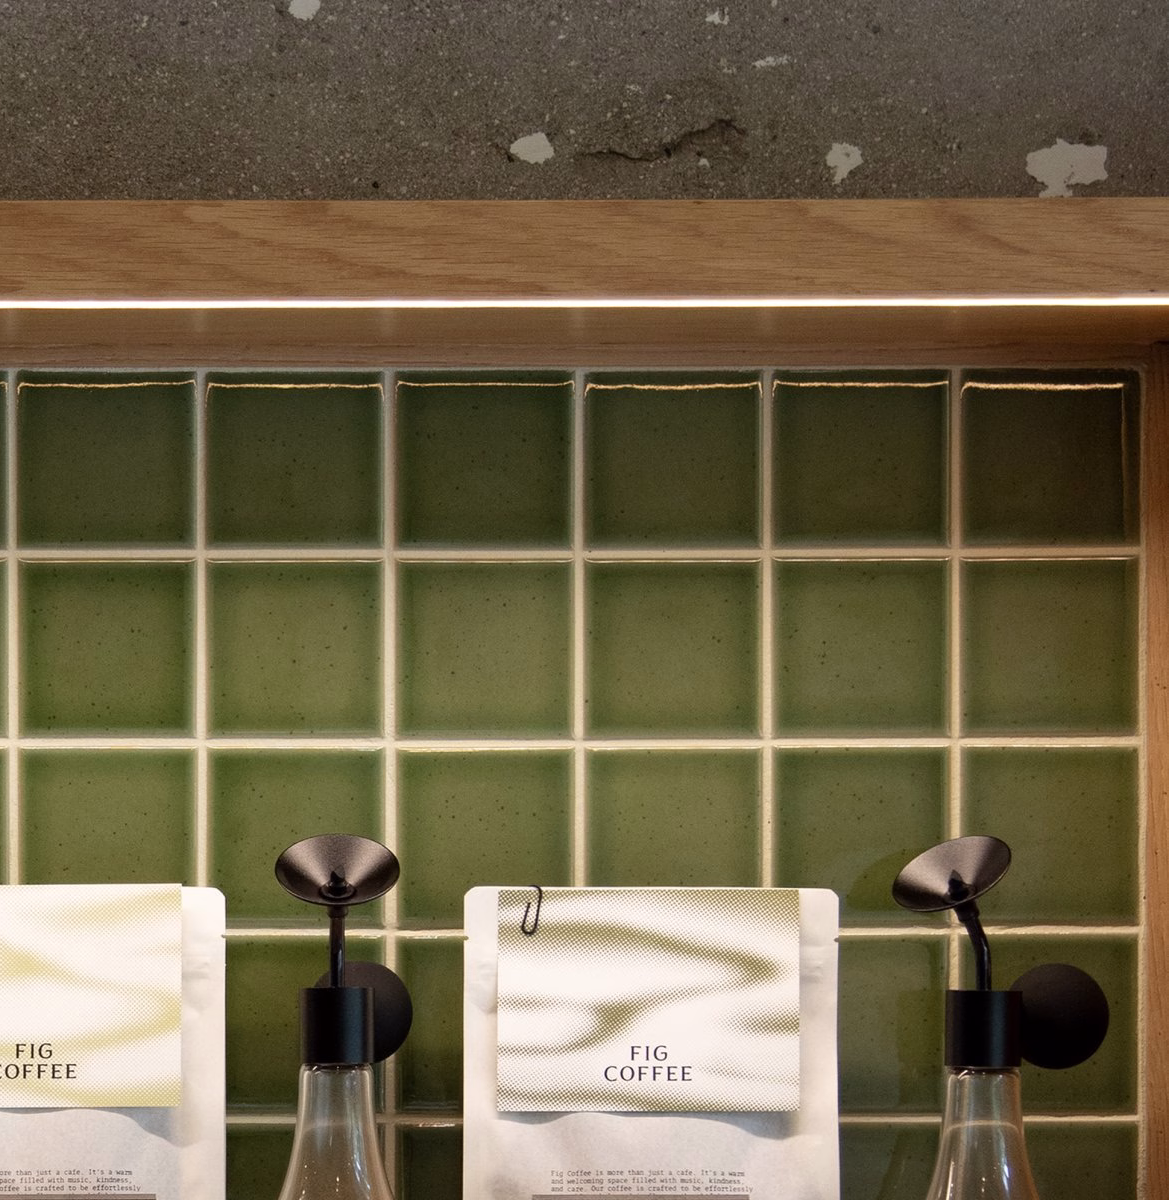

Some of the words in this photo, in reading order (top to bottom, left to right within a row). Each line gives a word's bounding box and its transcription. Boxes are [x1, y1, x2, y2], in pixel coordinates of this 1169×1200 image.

[15, 1043, 53, 1059] FIG
[630, 1045, 669, 1061] FIG
[604, 1065, 693, 1082] COFFEE
[35, 1169, 52, 1178] just
[551, 1170, 563, 1178] Fig
[647, 1169, 664, 1178] just
[67, 1177, 91, 1186] music,
[96, 1177, 131, 1185] kindness,
[567, 1178, 603, 1186] welcoming
[679, 1178, 703, 1186] music,
[707, 1178, 743, 1186] kindness,
[92, 1185, 141, 1193] effortlessly
[704, 1186, 753, 1194] effortlessly
